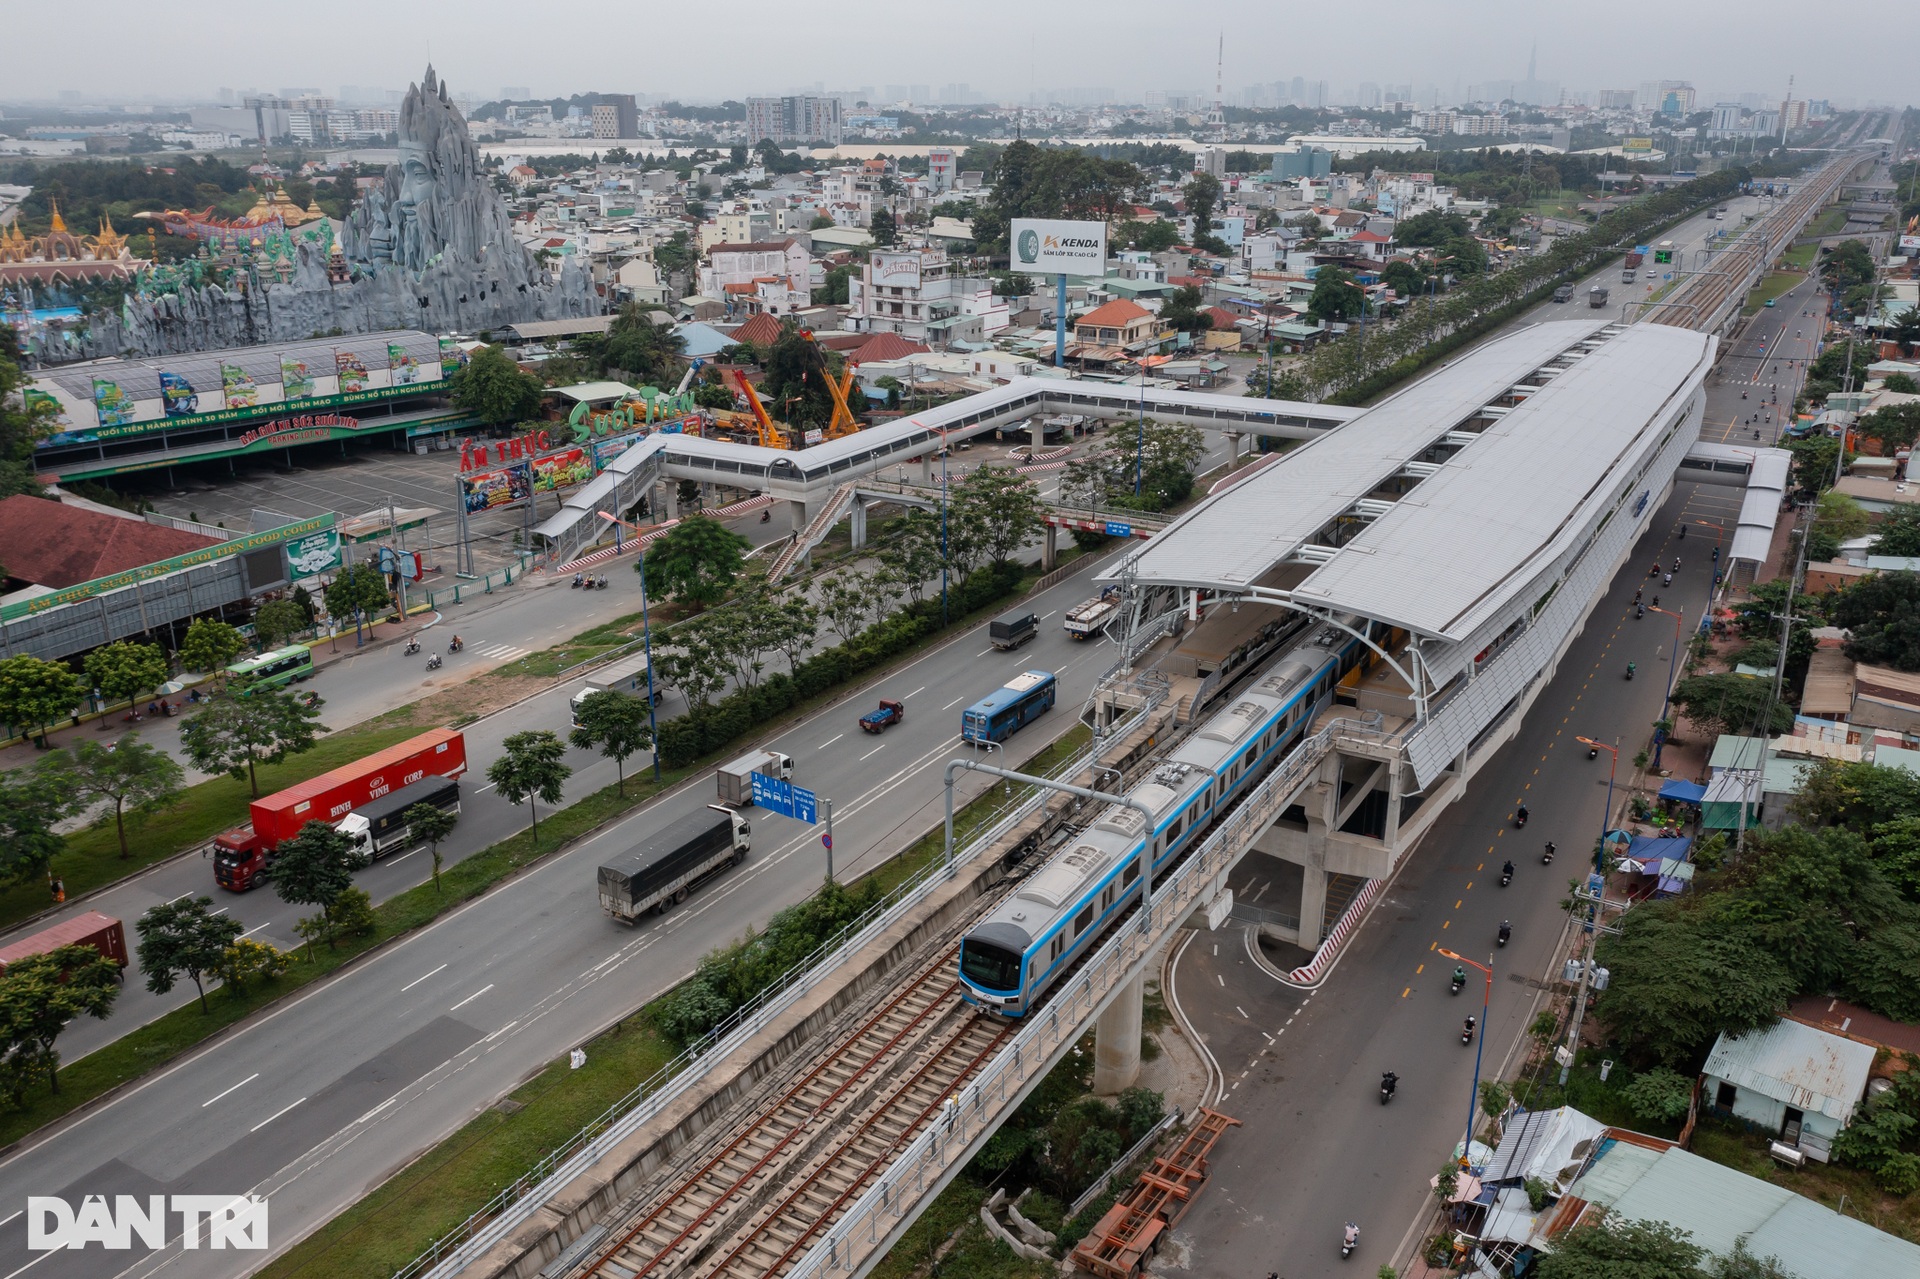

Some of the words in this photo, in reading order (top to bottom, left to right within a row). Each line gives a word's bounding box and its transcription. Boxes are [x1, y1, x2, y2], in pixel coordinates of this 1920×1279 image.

[1061, 238, 1098, 248] KENDA
[97, 427, 120, 437] SUỐI
[122, 424, 144, 434] TIÊN
[146, 420, 173, 430] HÀNH
[175, 416, 203, 426] TRÌNH
[270, 403, 286, 412] MỚI
[291, 400, 311, 410] DIỆN
[312, 398, 331, 408] MẠO
[343, 392, 366, 402] BÙNG
[381, 386, 398, 396] TRẢI
[400, 383, 429, 394] NGHIỆM
[277, 420, 291, 431] XE
[314, 413, 338, 426] SUỐI
[339, 416, 358, 428] TIÊN
[267, 431, 298, 444] PARKING
[300, 430, 313, 439] LOT
[324, 428, 330, 436] 2
[495, 429, 550, 462] THỰC
[56, 586, 96, 603] THỰC
[100, 573, 134, 590] SUỐI
[214, 542, 245, 557] TIEN
[248, 533, 280, 547] FOOD
[283, 520, 322, 537] COURT
[369, 784, 390, 800] VINH
[404, 770, 424, 785] CORP
